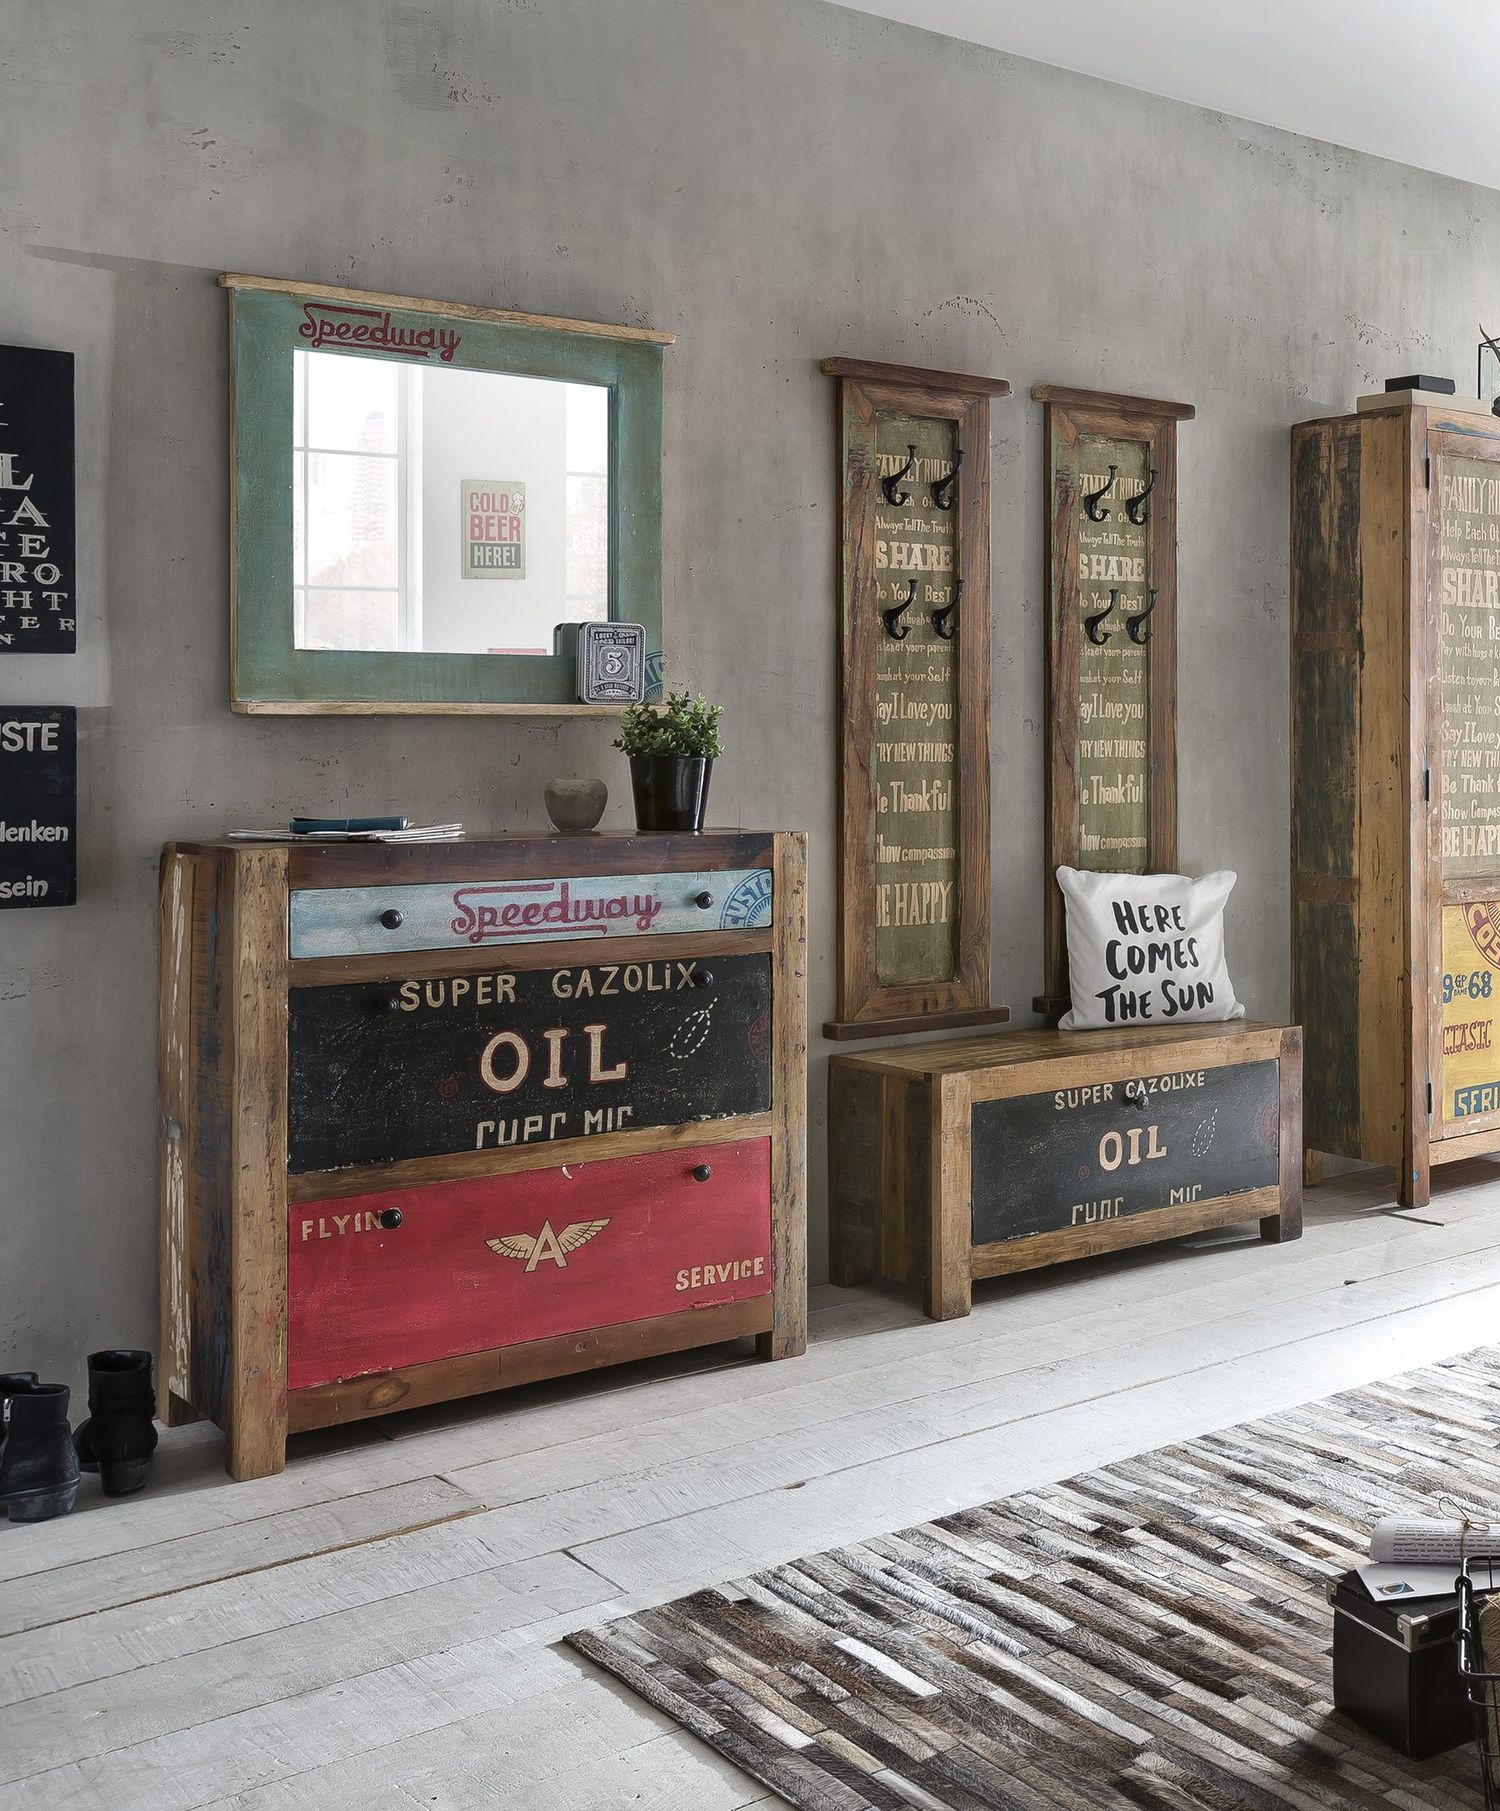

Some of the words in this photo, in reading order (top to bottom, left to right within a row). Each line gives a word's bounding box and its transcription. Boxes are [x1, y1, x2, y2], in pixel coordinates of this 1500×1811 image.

[299, 302, 462, 362] Speedway
[470, 492, 509, 513] COLD
[470, 515, 521, 542] BEER
[1441, 519, 1462, 543] Help
[1465, 520, 1487, 541] Each
[473, 545, 516, 567] HERE!
[875, 540, 954, 572] SHARE
[1079, 552, 1145, 582] SHARE
[925, 703, 953, 727] you
[1121, 703, 1145, 725] you
[0, 722, 60, 752] STE
[1441, 719, 1463, 748] Say
[1470, 721, 1495, 744] Love
[917, 742, 955, 763] THINGS
[1113, 740, 1146, 759] THINGS
[1460, 750, 1483, 768] NEW
[889, 779, 953, 813] Thankful
[1090, 773, 1144, 804] Thankful
[1441, 774, 1458, 795] Be
[1441, 799, 1468, 820] Show
[1441, 825, 1461, 858] BE
[452, 882, 662, 943] Speedway
[894, 879, 954, 927] HAPPY
[1112, 900, 1186, 936] HERE
[1105, 937, 1200, 980] COMES
[400, 974, 517, 1012] SUPER
[1468, 970, 1493, 1000] 68
[1095, 984, 1153, 1022] THE
[1161, 979, 1214, 1017] SUN
[480, 1023, 628, 1093] OIL
[1054, 1083, 1114, 1111] SUPER
[1099, 1125, 1167, 1171] OIL
[302, 1207, 403, 1242] FLYIN
[675, 1256, 766, 1292] SERVICE
